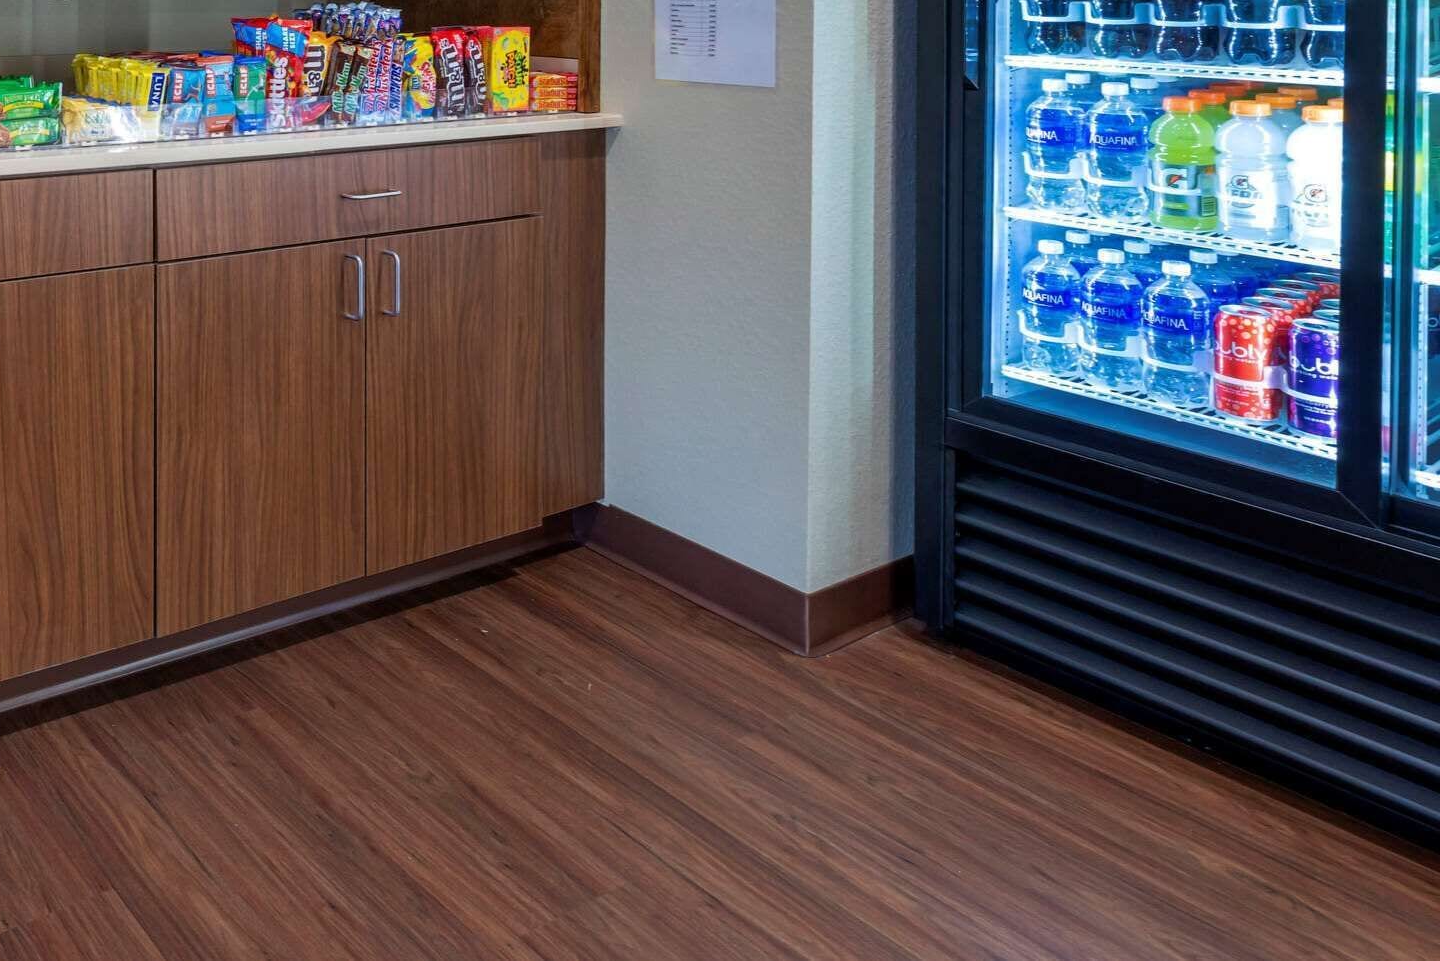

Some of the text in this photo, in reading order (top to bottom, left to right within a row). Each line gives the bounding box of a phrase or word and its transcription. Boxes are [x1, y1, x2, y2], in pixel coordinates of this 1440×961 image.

[152, 75, 164, 111] LUNA
[174, 73, 184, 93] CLIF
[240, 67, 248, 89] CLIF
[264, 57, 288, 128] Skittles
[390, 64, 402, 112] SNICKERS
